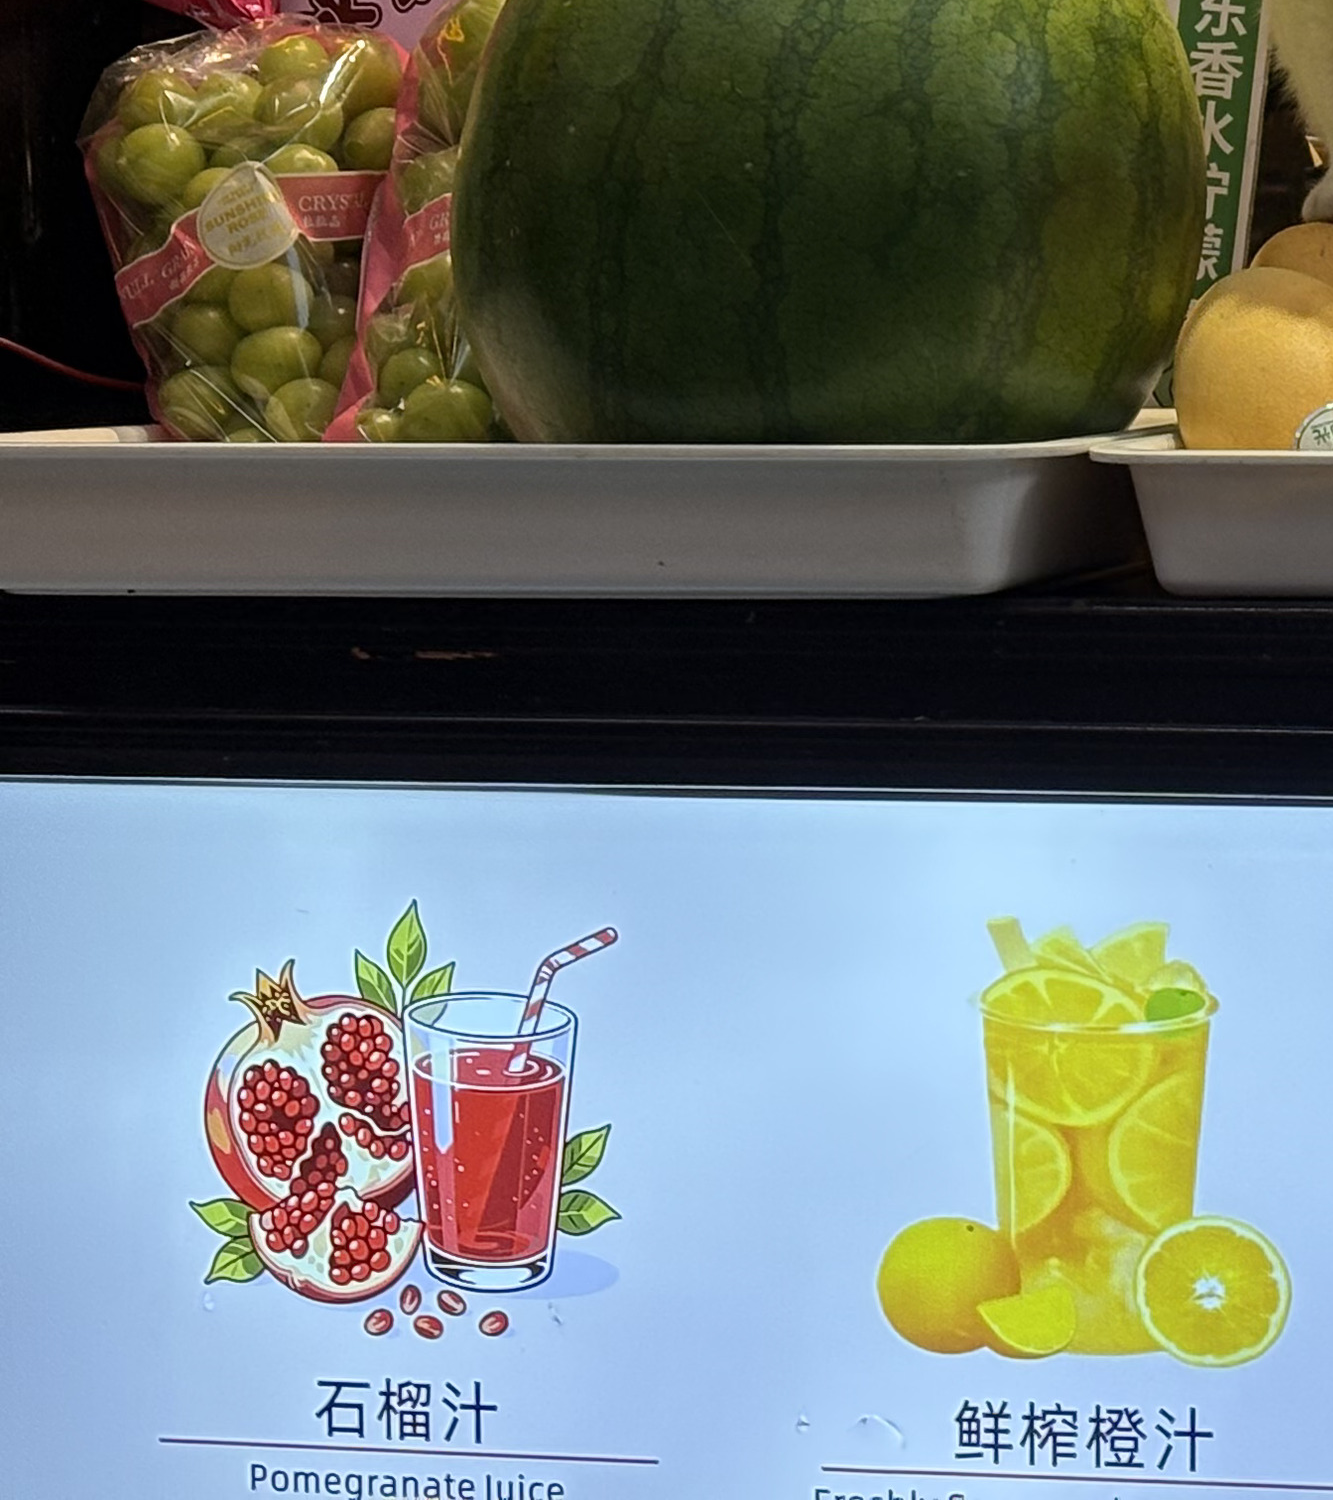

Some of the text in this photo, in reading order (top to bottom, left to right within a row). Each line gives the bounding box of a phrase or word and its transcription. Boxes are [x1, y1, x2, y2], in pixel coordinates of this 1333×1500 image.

[315, 1377, 498, 1444] 石榴汁
[954, 1399, 1214, 1473] 鲜榨橙汁
[250, 1463, 565, 1500] Pomegranate Juice
